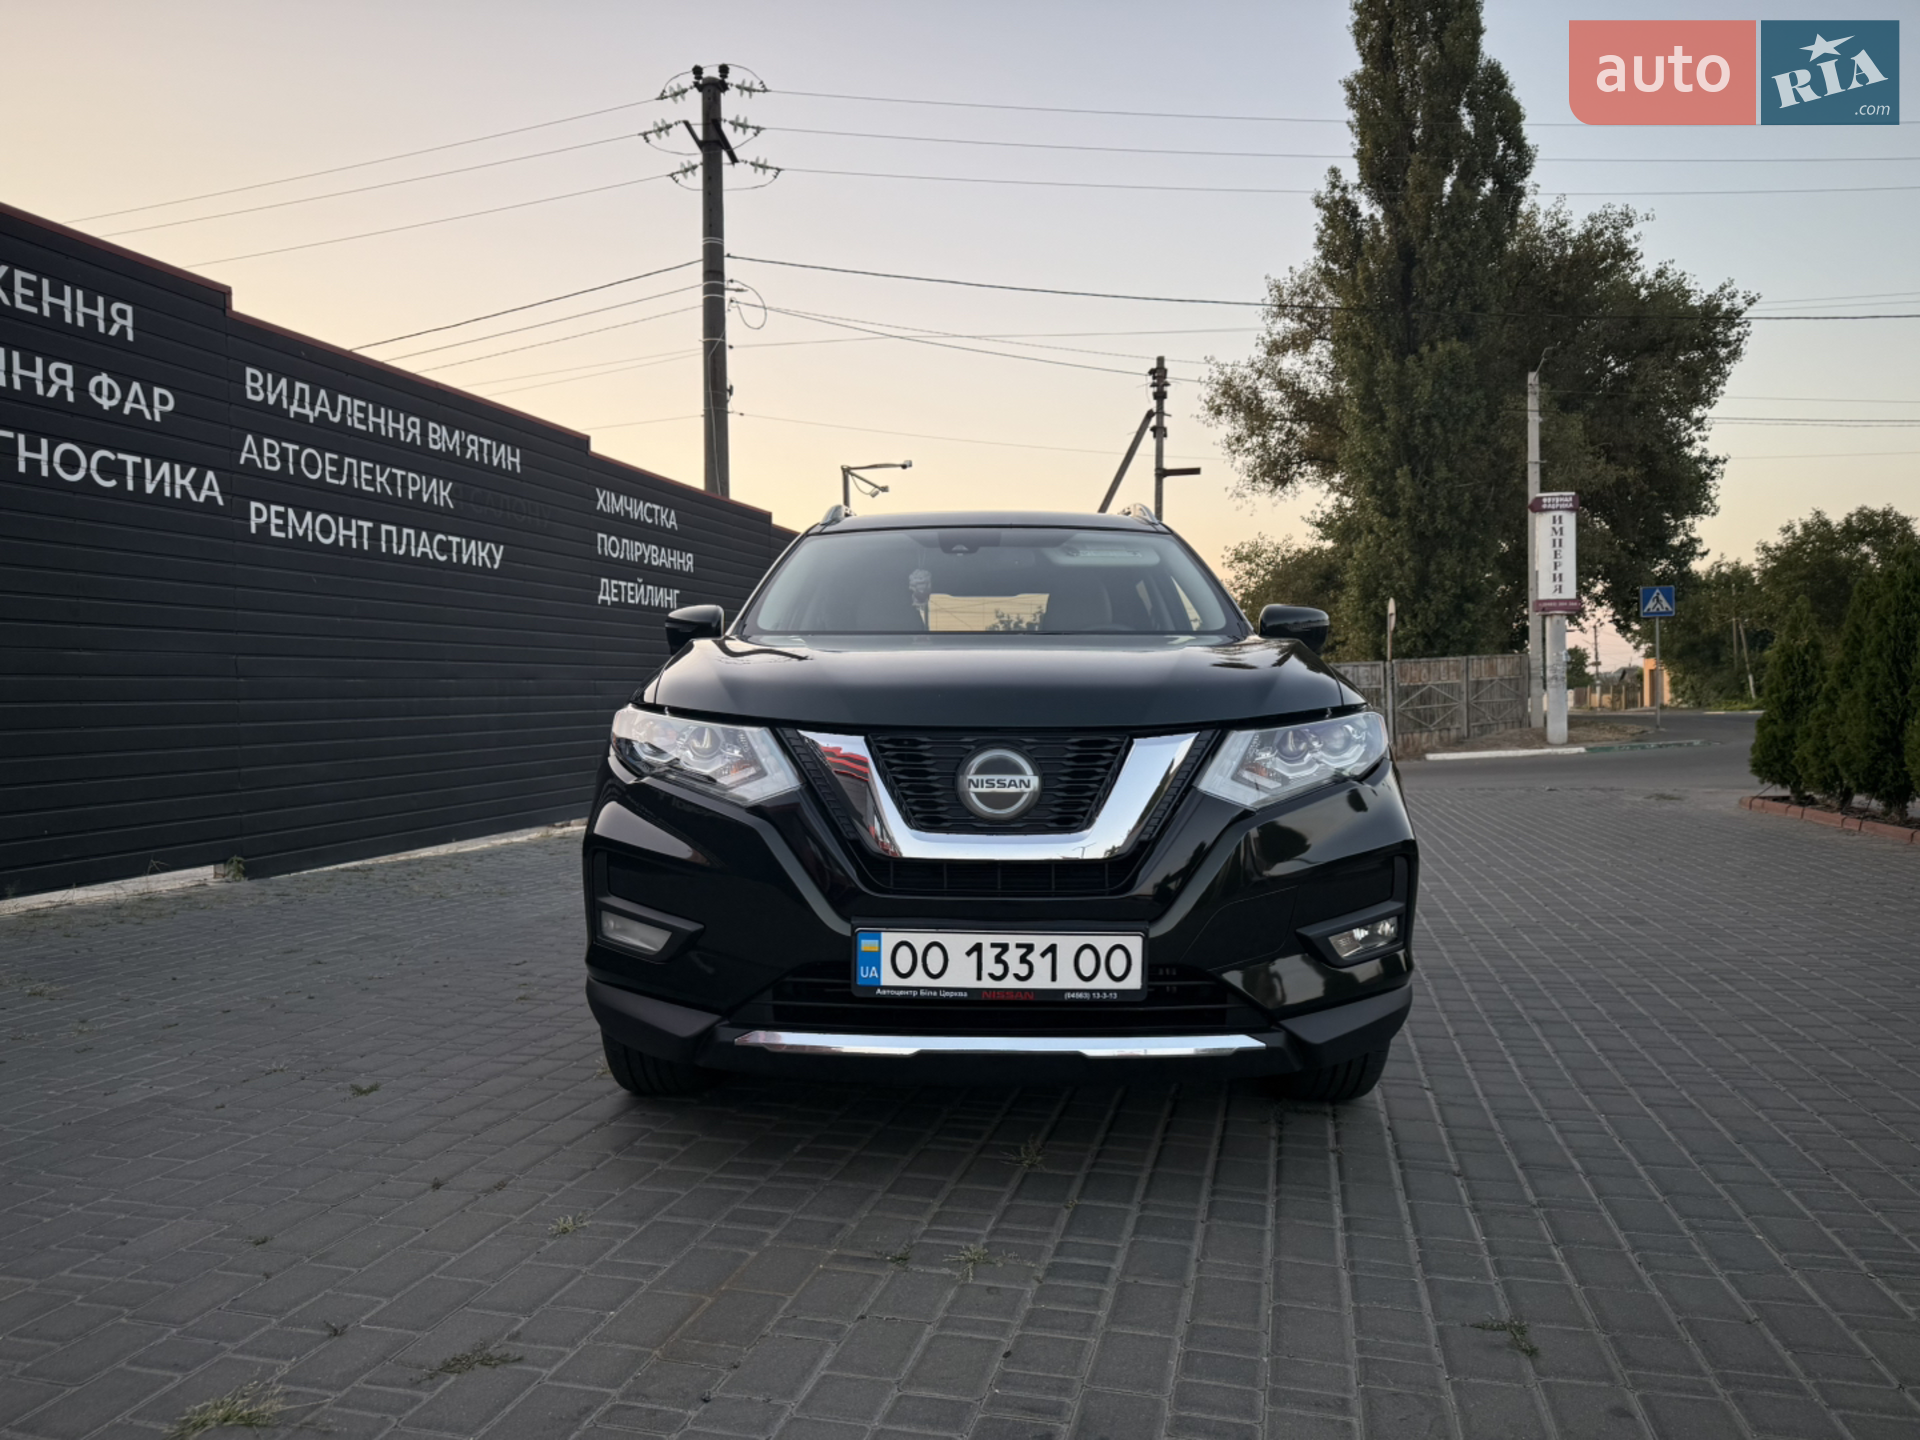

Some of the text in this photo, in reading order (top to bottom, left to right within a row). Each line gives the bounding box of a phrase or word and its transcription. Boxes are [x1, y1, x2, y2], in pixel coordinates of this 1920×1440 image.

[88, 371, 176, 423] ФАР
[245, 366, 421, 446] ВИДАЛЕННЯ
[239, 434, 455, 510] АВТОЕЛЕКТРИК
[595, 487, 679, 531] ХІМЧИСТКА
[250, 501, 504, 570] РЕМОНТ ПЛАСТИКУ
[597, 532, 695, 573] ПОЛІРУВАННЯ
[1550, 514, 1564, 595] ИМПЕРИЯ
[598, 577, 681, 609] ДЕТЕЙЛИНГ
[967, 778, 1031, 789] NISSAN
[860, 966, 879, 979] UA
[965, 942, 1057, 982] 1331
[981, 990, 1035, 1001] NISSAN
